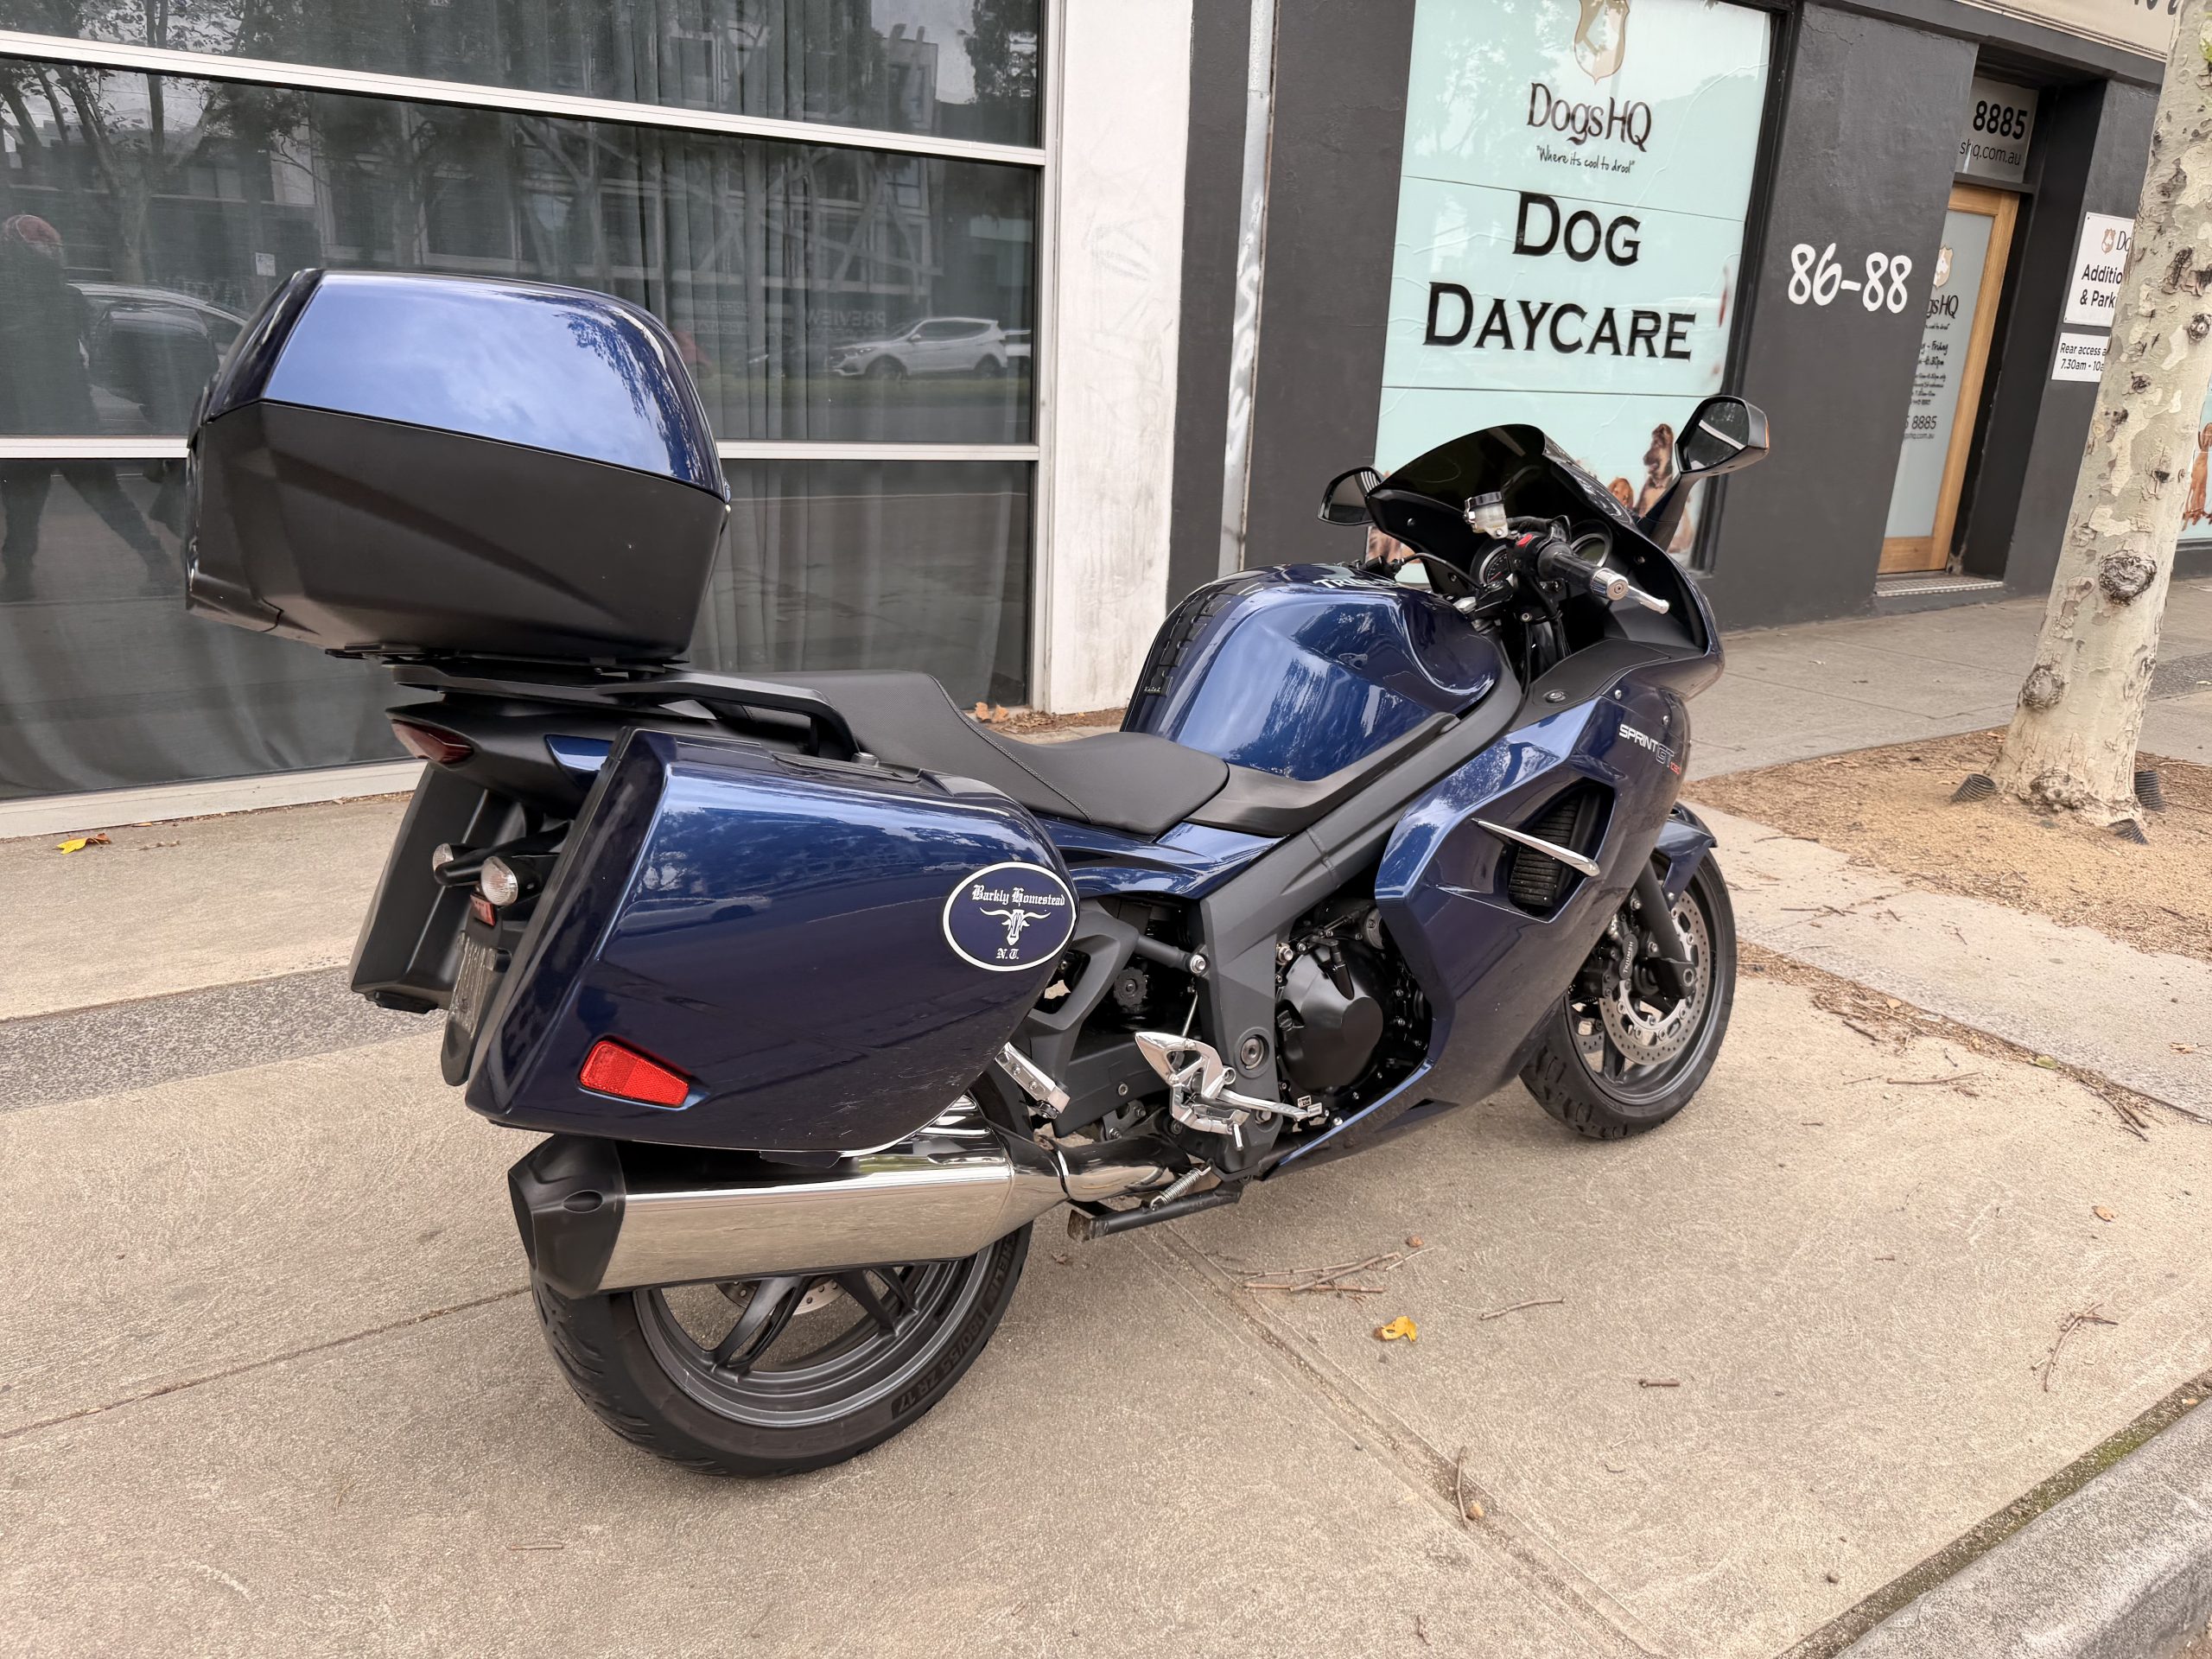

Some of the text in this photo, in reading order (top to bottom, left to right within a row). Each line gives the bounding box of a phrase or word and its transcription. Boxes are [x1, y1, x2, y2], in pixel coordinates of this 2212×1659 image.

[1527, 83, 1652, 152] DogsHQ
[1973, 100, 2028, 140] 8885
[1511, 191, 1641, 266] DOG
[1788, 243, 1912, 314] 86-88
[2081, 264, 2123, 284] Additio
[2080, 289, 2116, 308] & Park
[1422, 282, 1696, 361] DAYCARE
[2060, 342, 2078, 354] Rear
[2078, 346, 2101, 356] access
[2061, 358, 2087, 371] 7.30am
[1911, 416, 1937, 429] 8885
[972, 884, 1065, 906] Barkly Homestead
